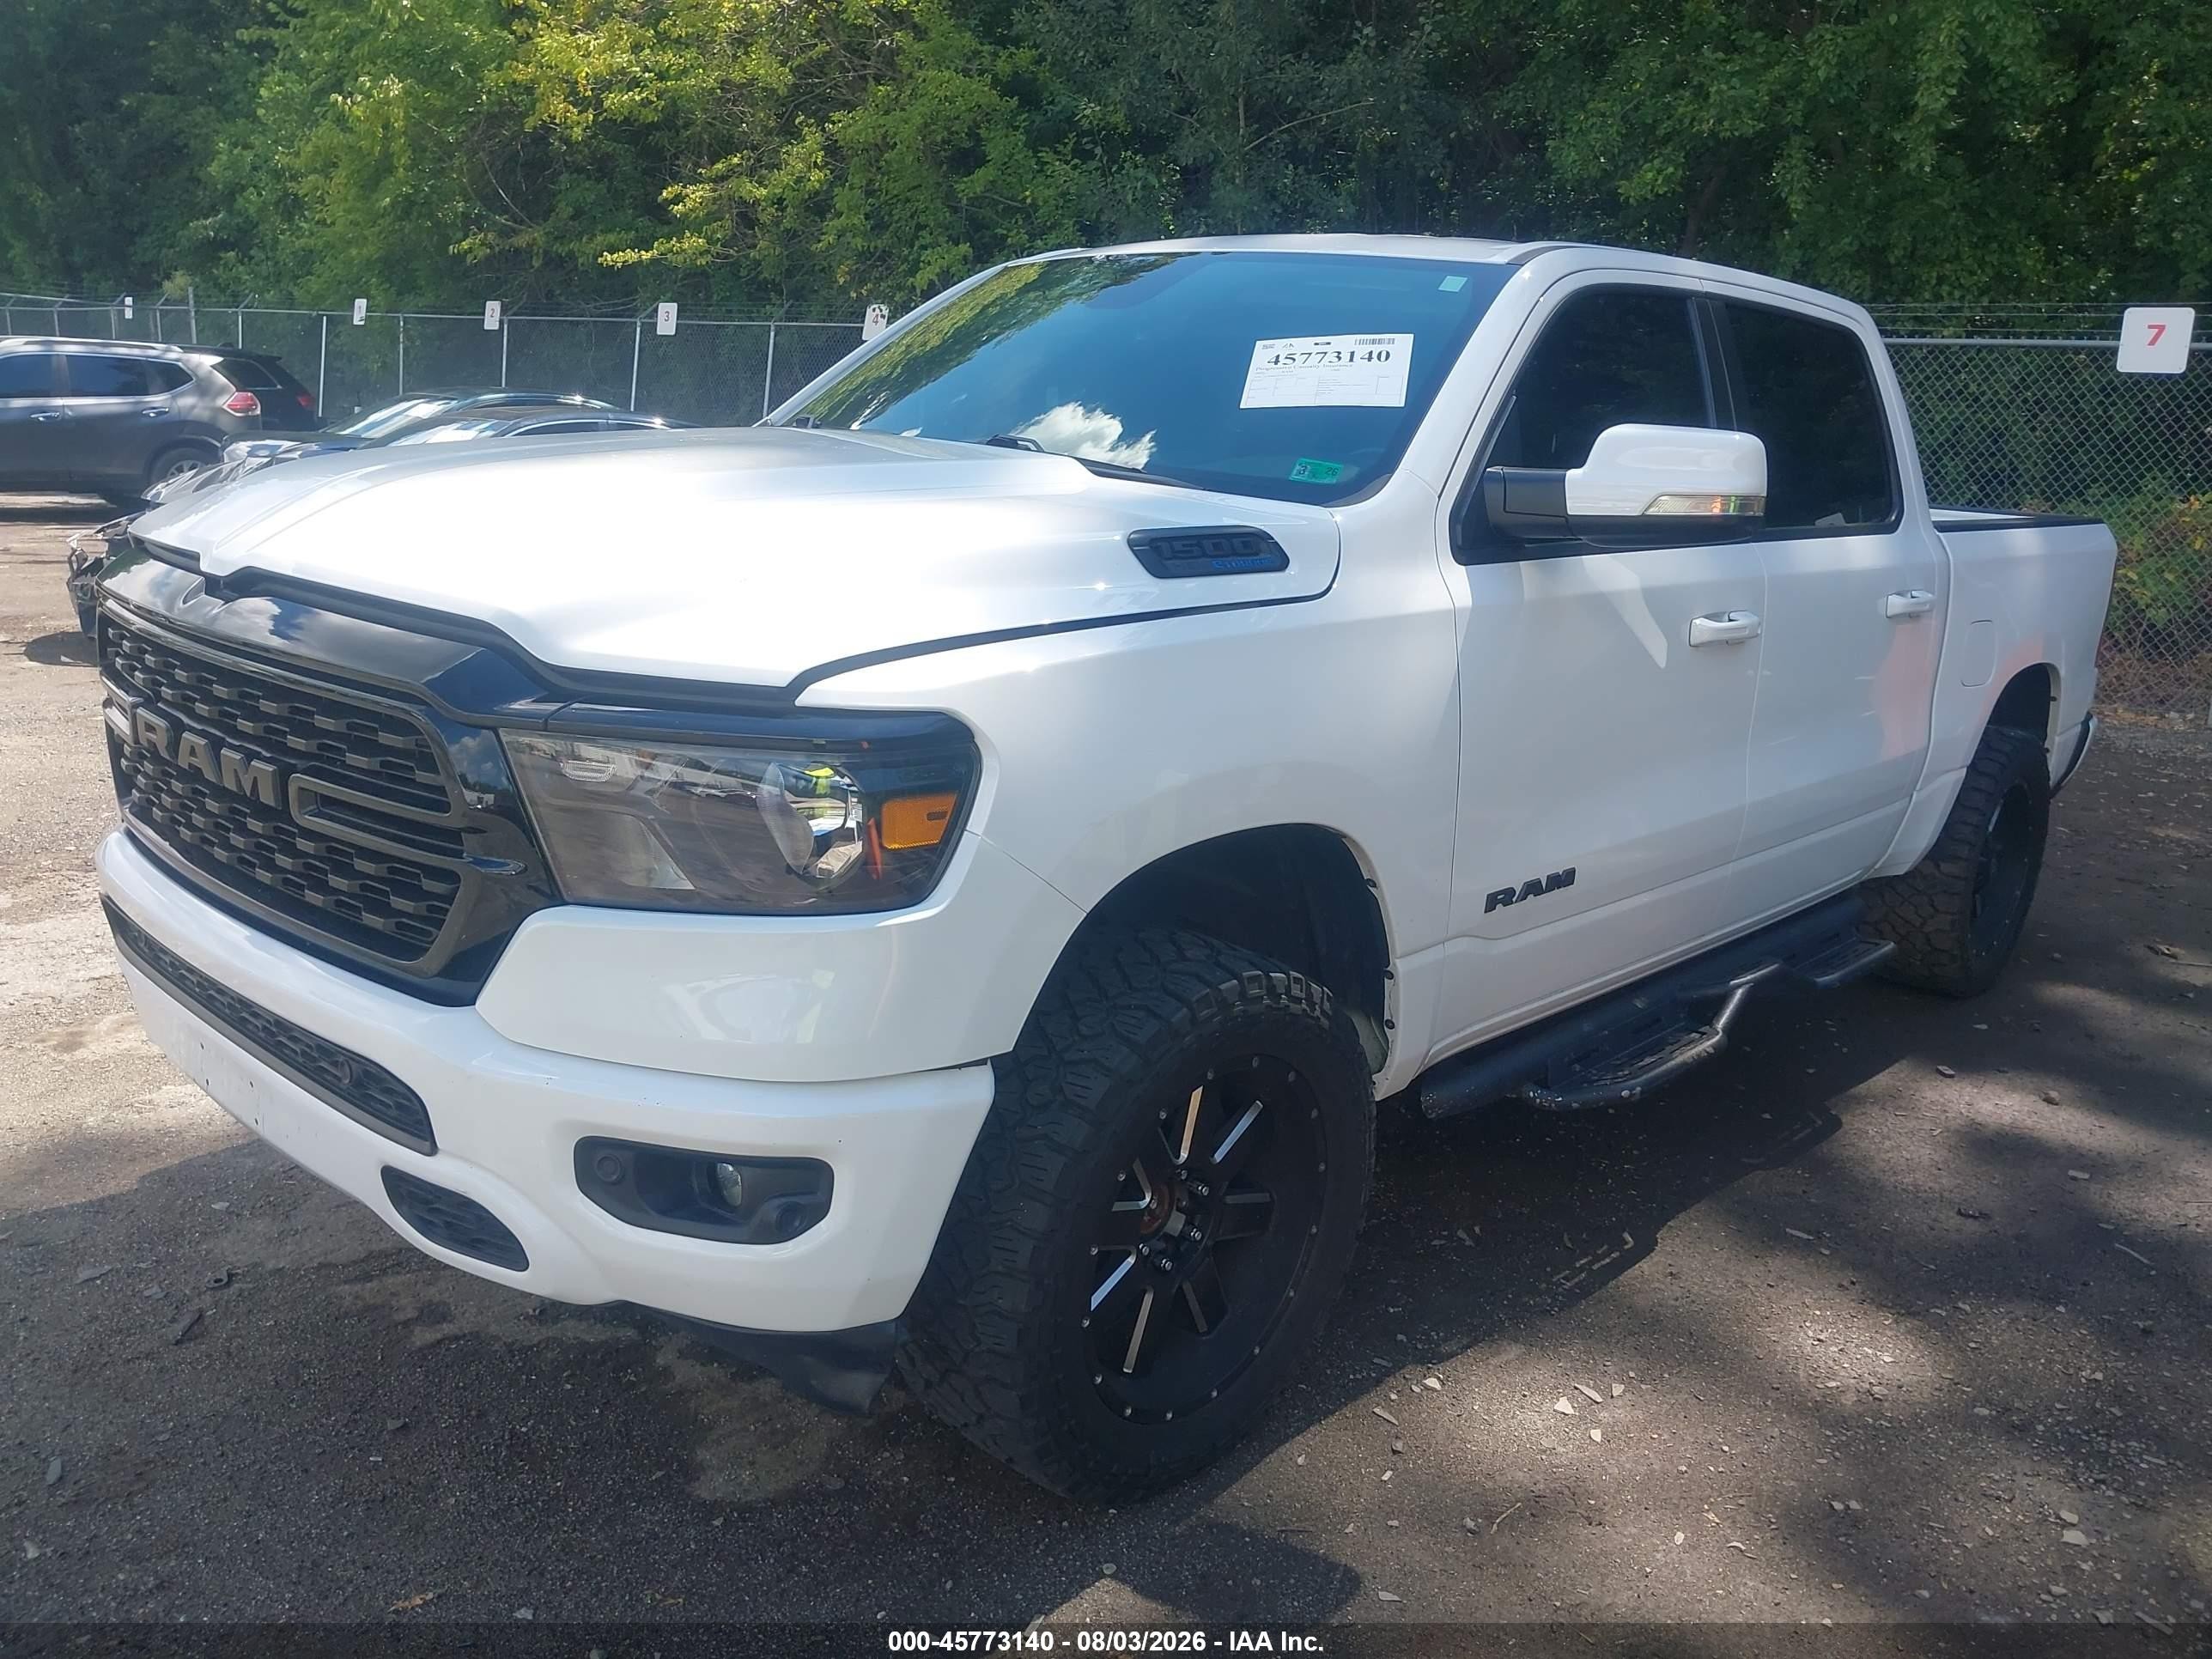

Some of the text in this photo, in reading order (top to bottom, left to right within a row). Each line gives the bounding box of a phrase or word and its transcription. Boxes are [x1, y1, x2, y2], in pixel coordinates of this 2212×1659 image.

[490, 307, 495, 318] 2
[664, 310, 670, 322] 3
[872, 313, 879, 325] 4
[2147, 324, 2166, 346] 7
[1267, 349, 1391, 366] 45773140
[1151, 538, 1261, 559] 1500
[135, 706, 283, 810] RAM
[1484, 866, 1577, 914] RAM
